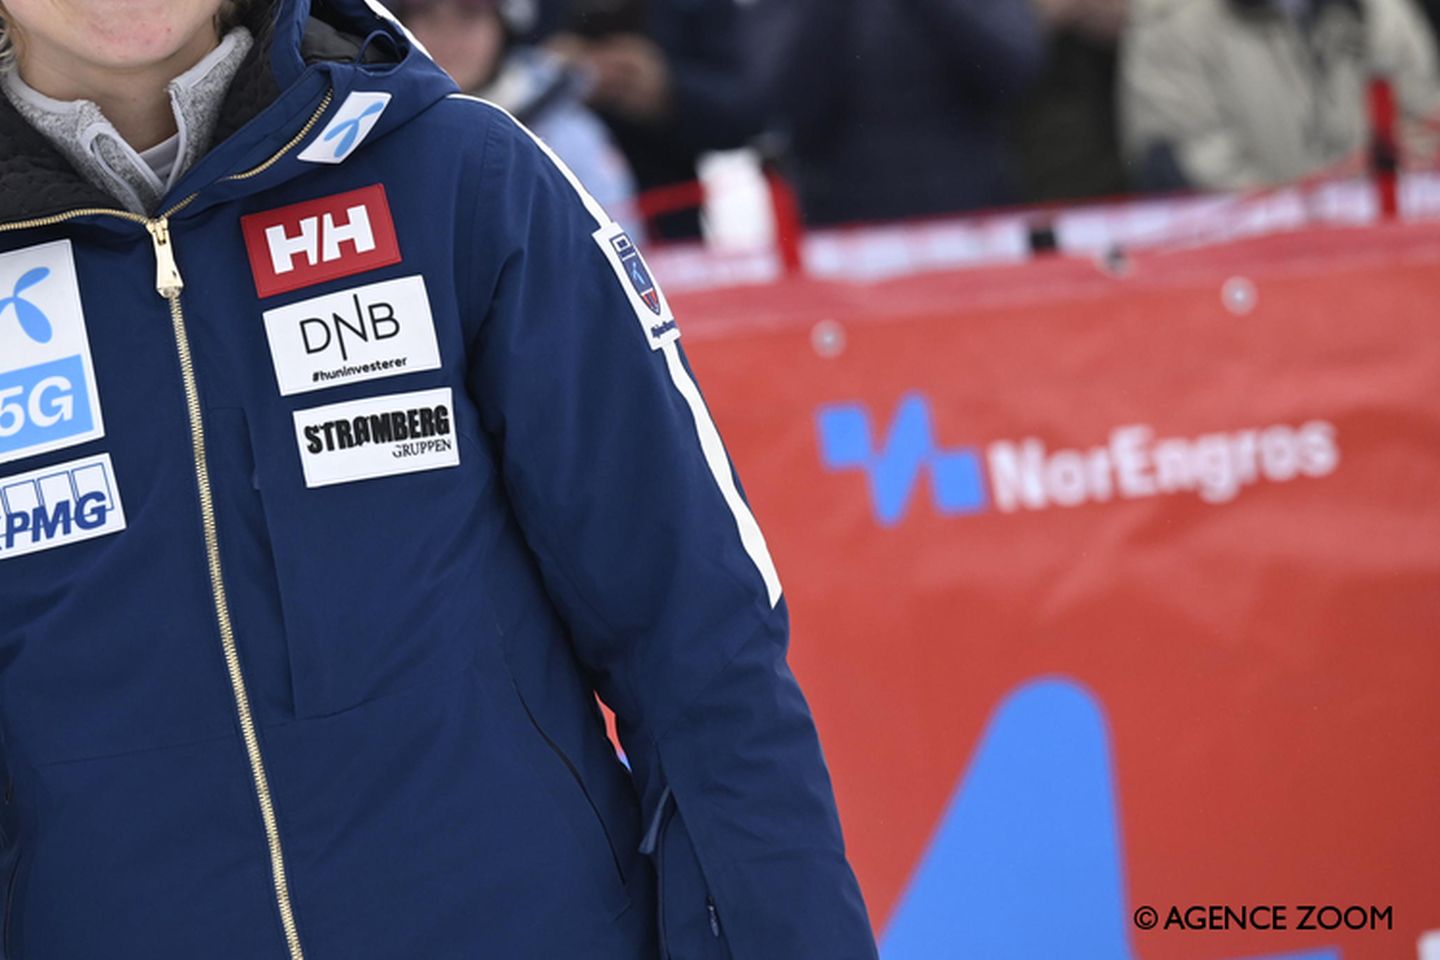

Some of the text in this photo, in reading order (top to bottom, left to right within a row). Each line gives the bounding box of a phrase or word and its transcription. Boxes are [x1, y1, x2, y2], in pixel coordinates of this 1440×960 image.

[265, 204, 376, 275] HH
[299, 293, 401, 361] DNB
[311, 356, 409, 383] #huninvesterer
[391, 439, 452, 459] GRUPPEN
[987, 421, 1340, 512] NorEngros
